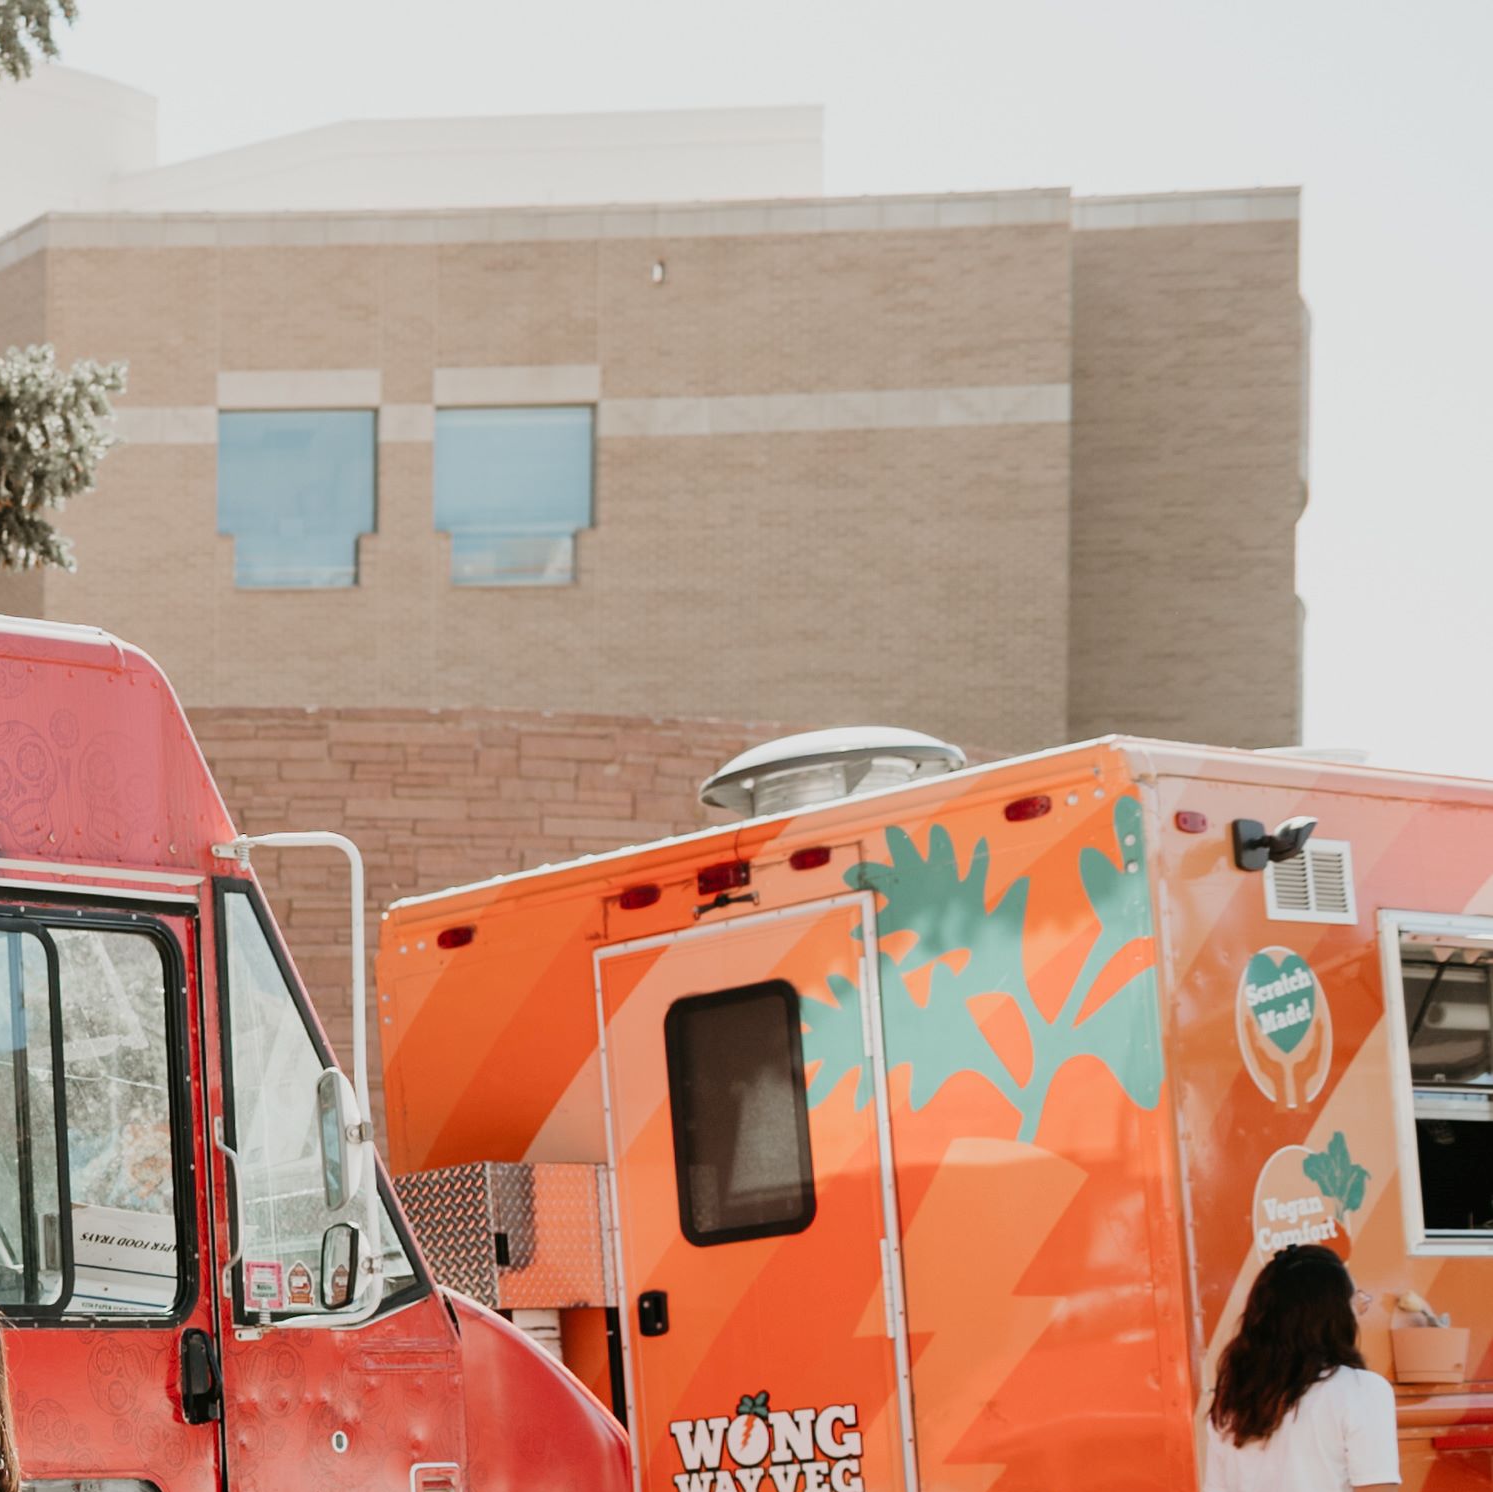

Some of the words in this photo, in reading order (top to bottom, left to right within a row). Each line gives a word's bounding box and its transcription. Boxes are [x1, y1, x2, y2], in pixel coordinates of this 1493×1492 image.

[1246, 967, 1312, 1007] Scratch
[1258, 998, 1311, 1034] Made!
[1262, 1196, 1324, 1224] Vegan
[80, 1232, 115, 1245] TRAYS
[117, 1237, 150, 1250] FOOD
[1258, 1216, 1338, 1251] Comfort
[669, 1403, 863, 1472] WONG
